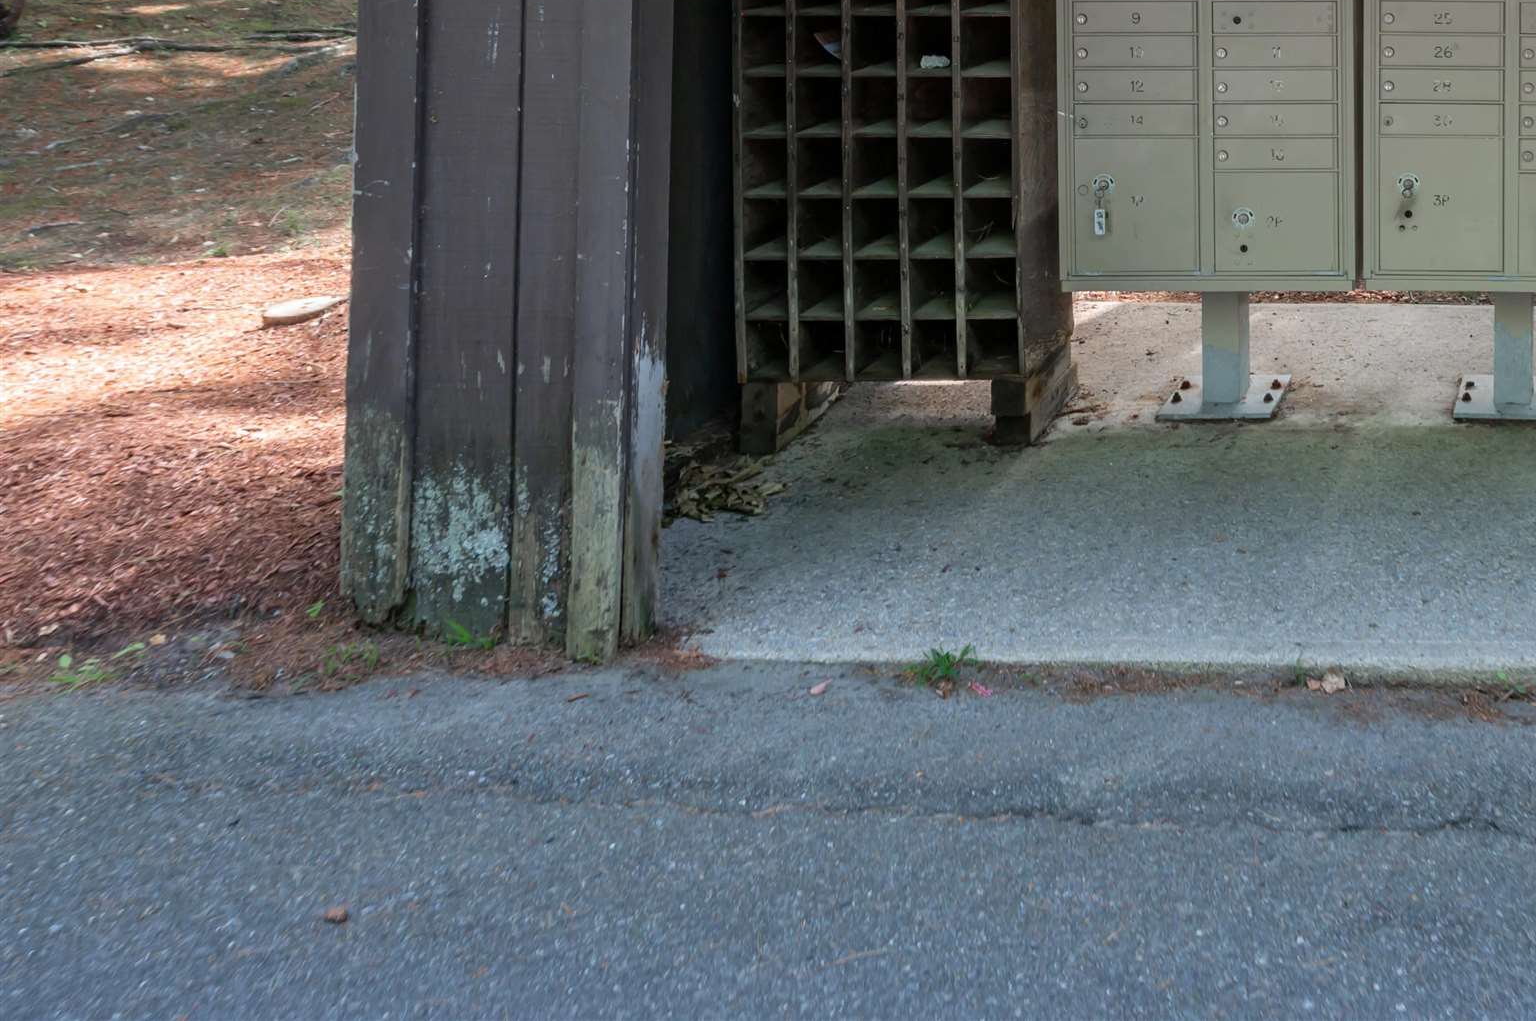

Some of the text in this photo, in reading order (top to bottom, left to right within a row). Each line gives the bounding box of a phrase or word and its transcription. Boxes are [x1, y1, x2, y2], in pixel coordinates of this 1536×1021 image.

[1131, 12, 1141, 25] 9
[1434, 12, 1452, 25] 25
[1434, 46, 1453, 59] 26
[1130, 80, 1144, 93] 12
[1433, 195, 1449, 207] 3P
